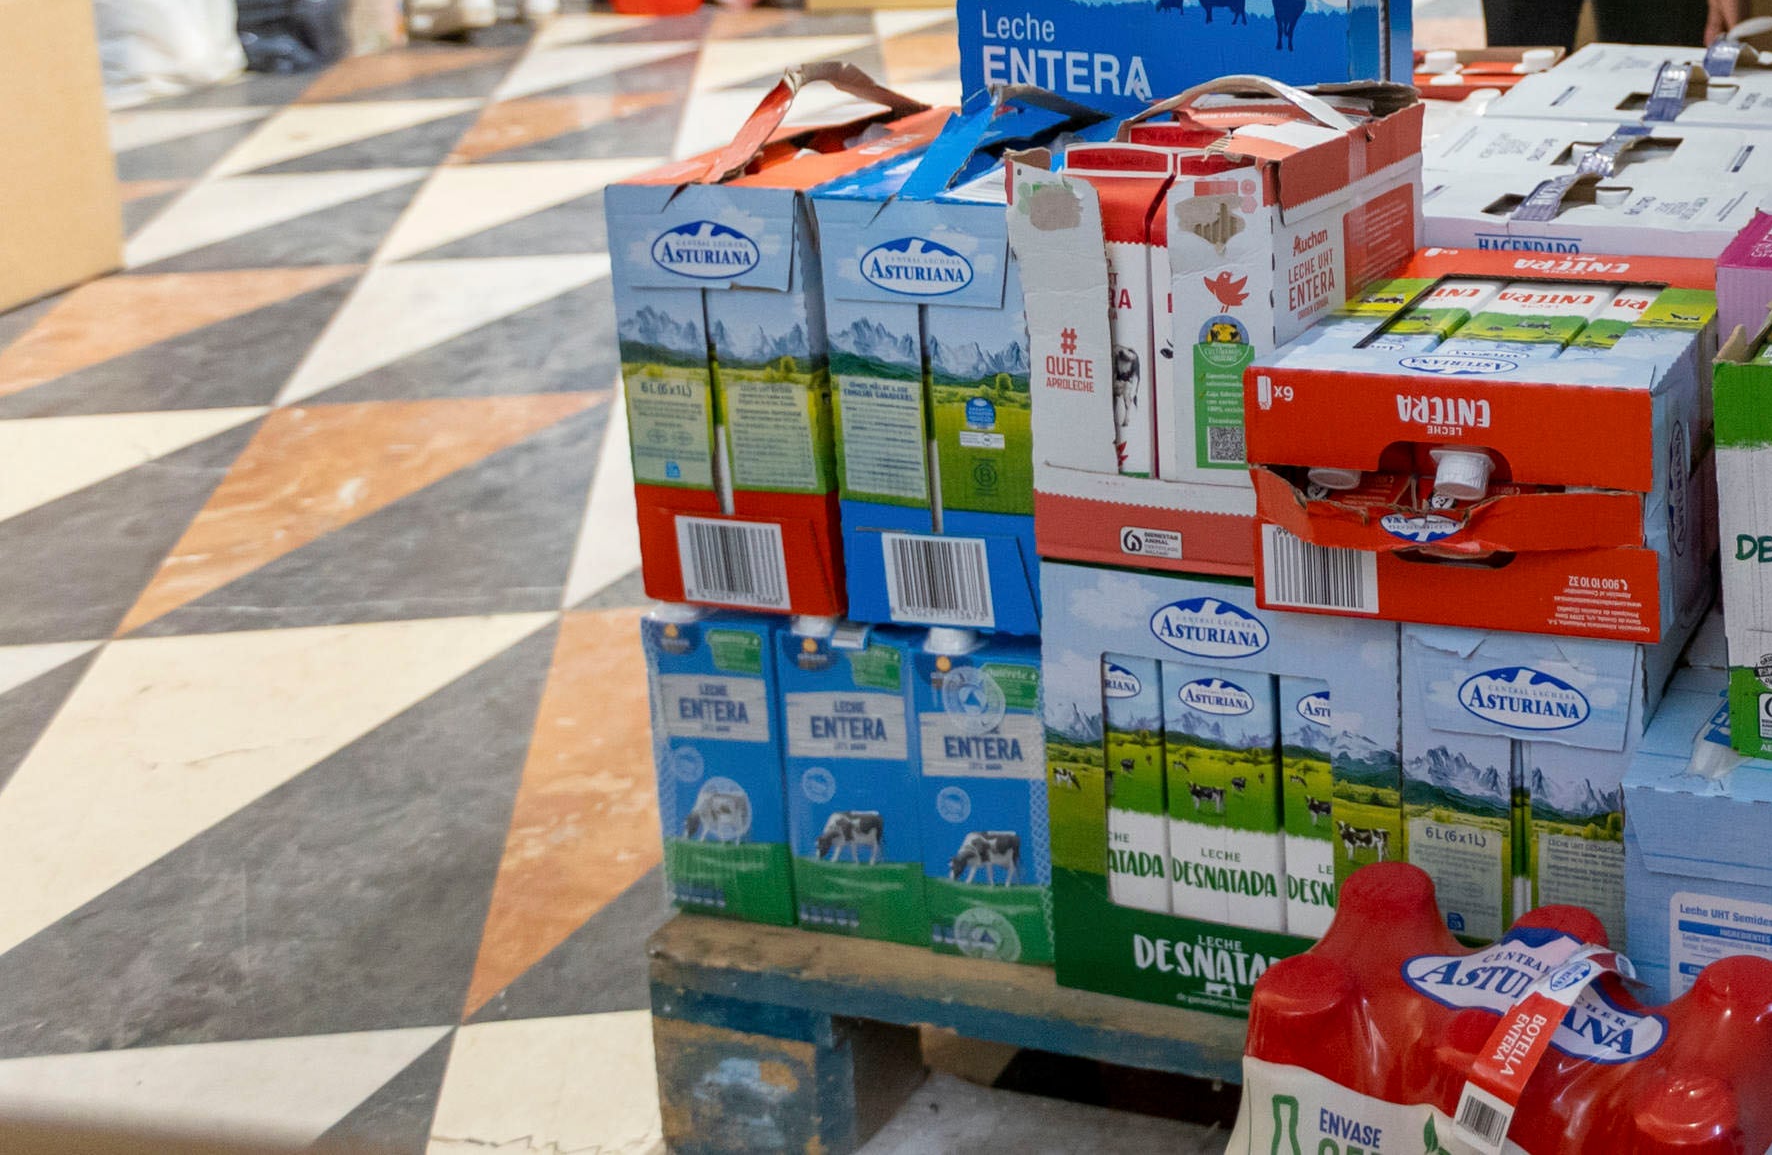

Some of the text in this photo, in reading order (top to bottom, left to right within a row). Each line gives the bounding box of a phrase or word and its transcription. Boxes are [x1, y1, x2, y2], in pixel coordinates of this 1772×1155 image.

[982, 9, 1055, 42] Leche
[982, 44, 1152, 99] ENTERA
[660, 241, 751, 267] ASTURIANA
[1293, 229, 1327, 257] Auchan
[870, 259, 964, 285] ASTURIANA
[1288, 248, 1333, 284] LECHE UHT
[1289, 267, 1335, 312] ENTERA
[1498, 293, 1595, 305] ENTERA
[1060, 327, 1077, 355] #
[1046, 355, 1093, 379] QUETE
[1411, 358, 1508, 371] ASTURIANA
[1046, 377, 1095, 393] APROLECHE
[1397, 393, 1490, 428] ENTERA
[1427, 425, 1462, 436] LECHE
[1568, 575, 1619, 589] 900 10 10 32
[1159, 614, 1260, 648] ASTURIANA
[700, 683, 727, 696] LECHE
[1184, 689, 1249, 711] ASTURIANA
[1468, 684, 1580, 719] ASTURIANA
[678, 697, 749, 724] ENTERA
[833, 700, 865, 714] LECHE
[810, 716, 887, 742] ENTERA
[943, 735, 1024, 762] ENTERA
[1425, 826, 1434, 839] 6
[1435, 828, 1442, 840] L
[1445, 829, 1456, 844] (6
[1457, 834, 1466, 844] x
[1200, 849, 1241, 863] LECHE
[1172, 860, 1277, 899] DESNATADA
[1287, 878, 1334, 908] DESN
[1680, 903, 1708, 918] Leche
[1711, 908, 1730, 921] UHT
[1198, 934, 1242, 952] LECHE
[1492, 1012, 1530, 1062] ENTERA
[1500, 1013, 1548, 1076] BOTELLA
[1318, 1107, 1383, 1150] ENVASE
